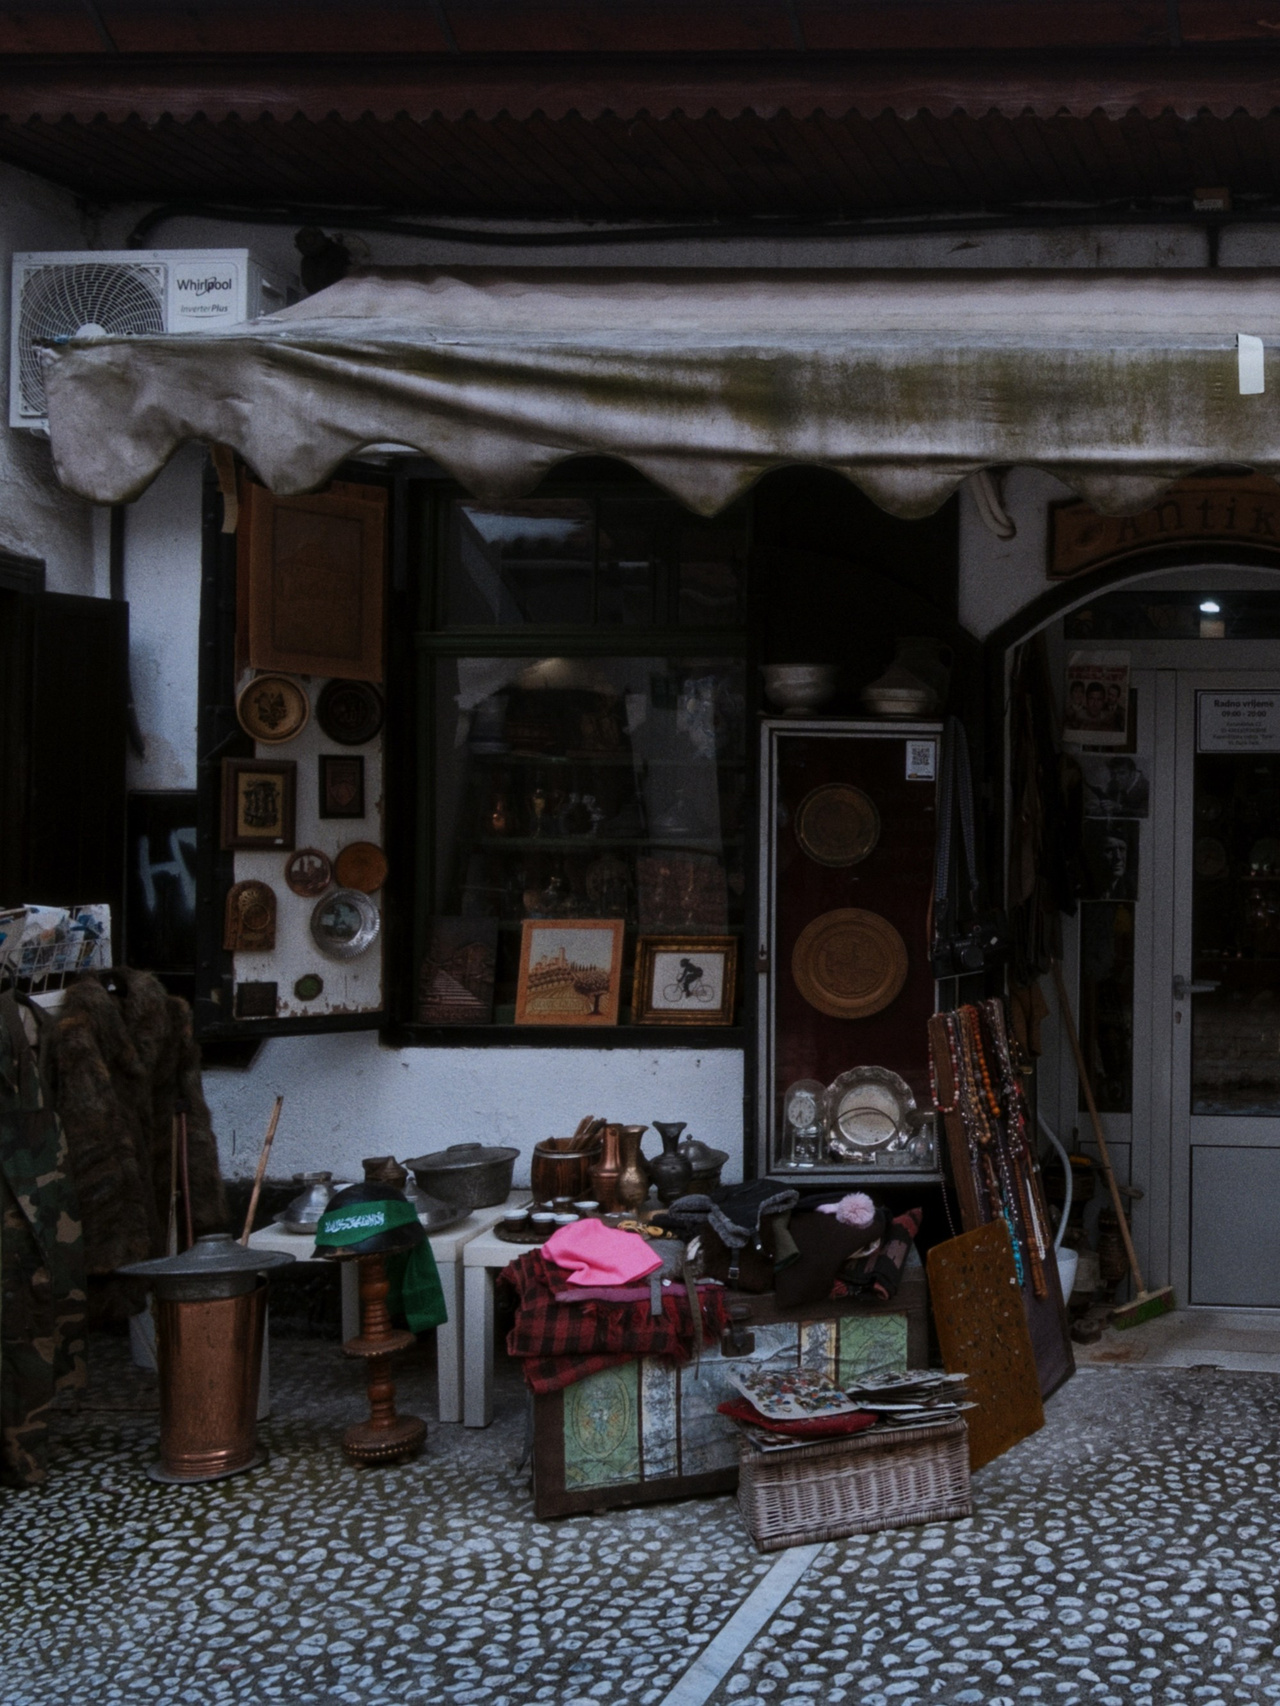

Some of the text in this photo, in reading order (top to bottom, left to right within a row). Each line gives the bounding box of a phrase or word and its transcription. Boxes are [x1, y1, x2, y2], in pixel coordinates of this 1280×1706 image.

[177, 278, 232, 294] Whirlpool
[1213, 699, 1274, 709] Radno vrijeme
[1221, 710, 1241, 718] 09:00
